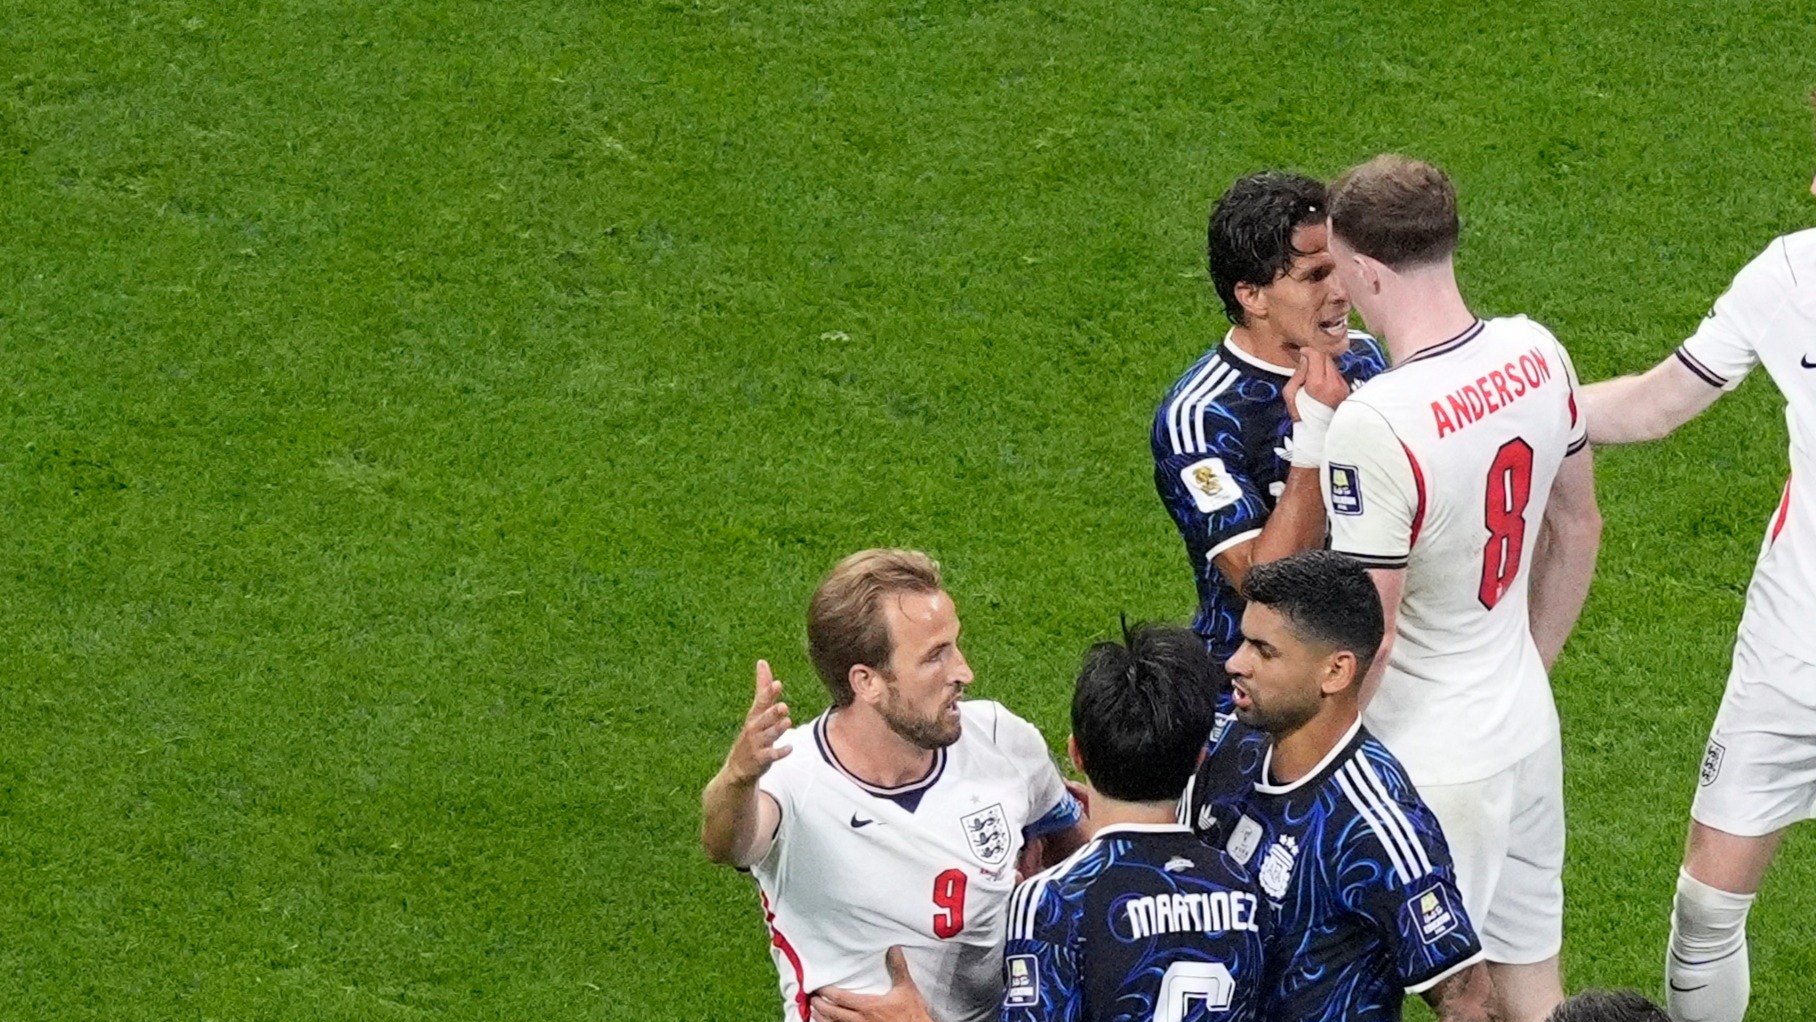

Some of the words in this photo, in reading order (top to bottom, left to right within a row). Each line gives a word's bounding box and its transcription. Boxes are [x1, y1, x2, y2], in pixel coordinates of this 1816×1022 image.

[1430, 346, 1551, 439] ANDERSON
[1478, 435, 1534, 611] 8
[932, 868, 968, 939] 9
[1126, 891, 1260, 940] MARTINEZ
